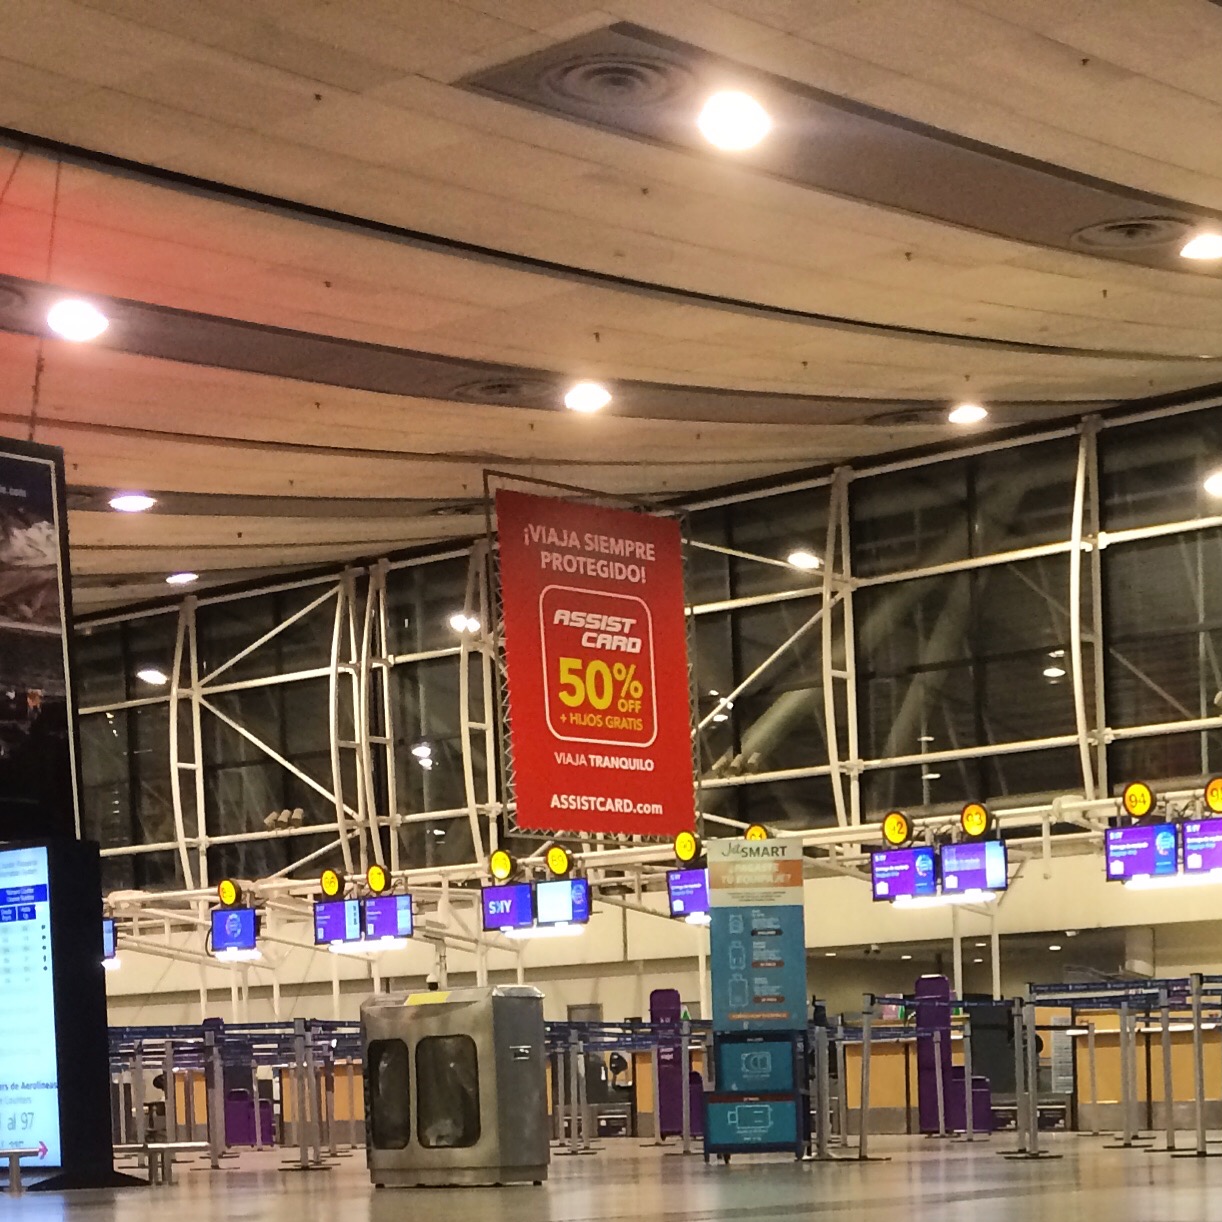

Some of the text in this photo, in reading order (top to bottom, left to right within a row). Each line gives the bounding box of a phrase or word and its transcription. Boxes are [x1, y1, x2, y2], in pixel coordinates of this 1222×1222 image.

[524, 523, 656, 561] ¡VIAJA SIEMPRE
[541, 551, 646, 584] PROTEGIDO!
[553, 609, 637, 634] ASSIST
[581, 631, 642, 653] CARD
[559, 656, 643, 710] 50%
[617, 699, 642, 713] OFF
[570, 713, 603, 727] HIJOS
[605, 716, 643, 731] GRATIS
[554, 752, 654, 771] VIAJA TRANQUILO
[550, 793, 663, 815] ASSISTCARD.com
[1128, 792, 1147, 808] 94
[21, 1111, 34, 1131] 97
